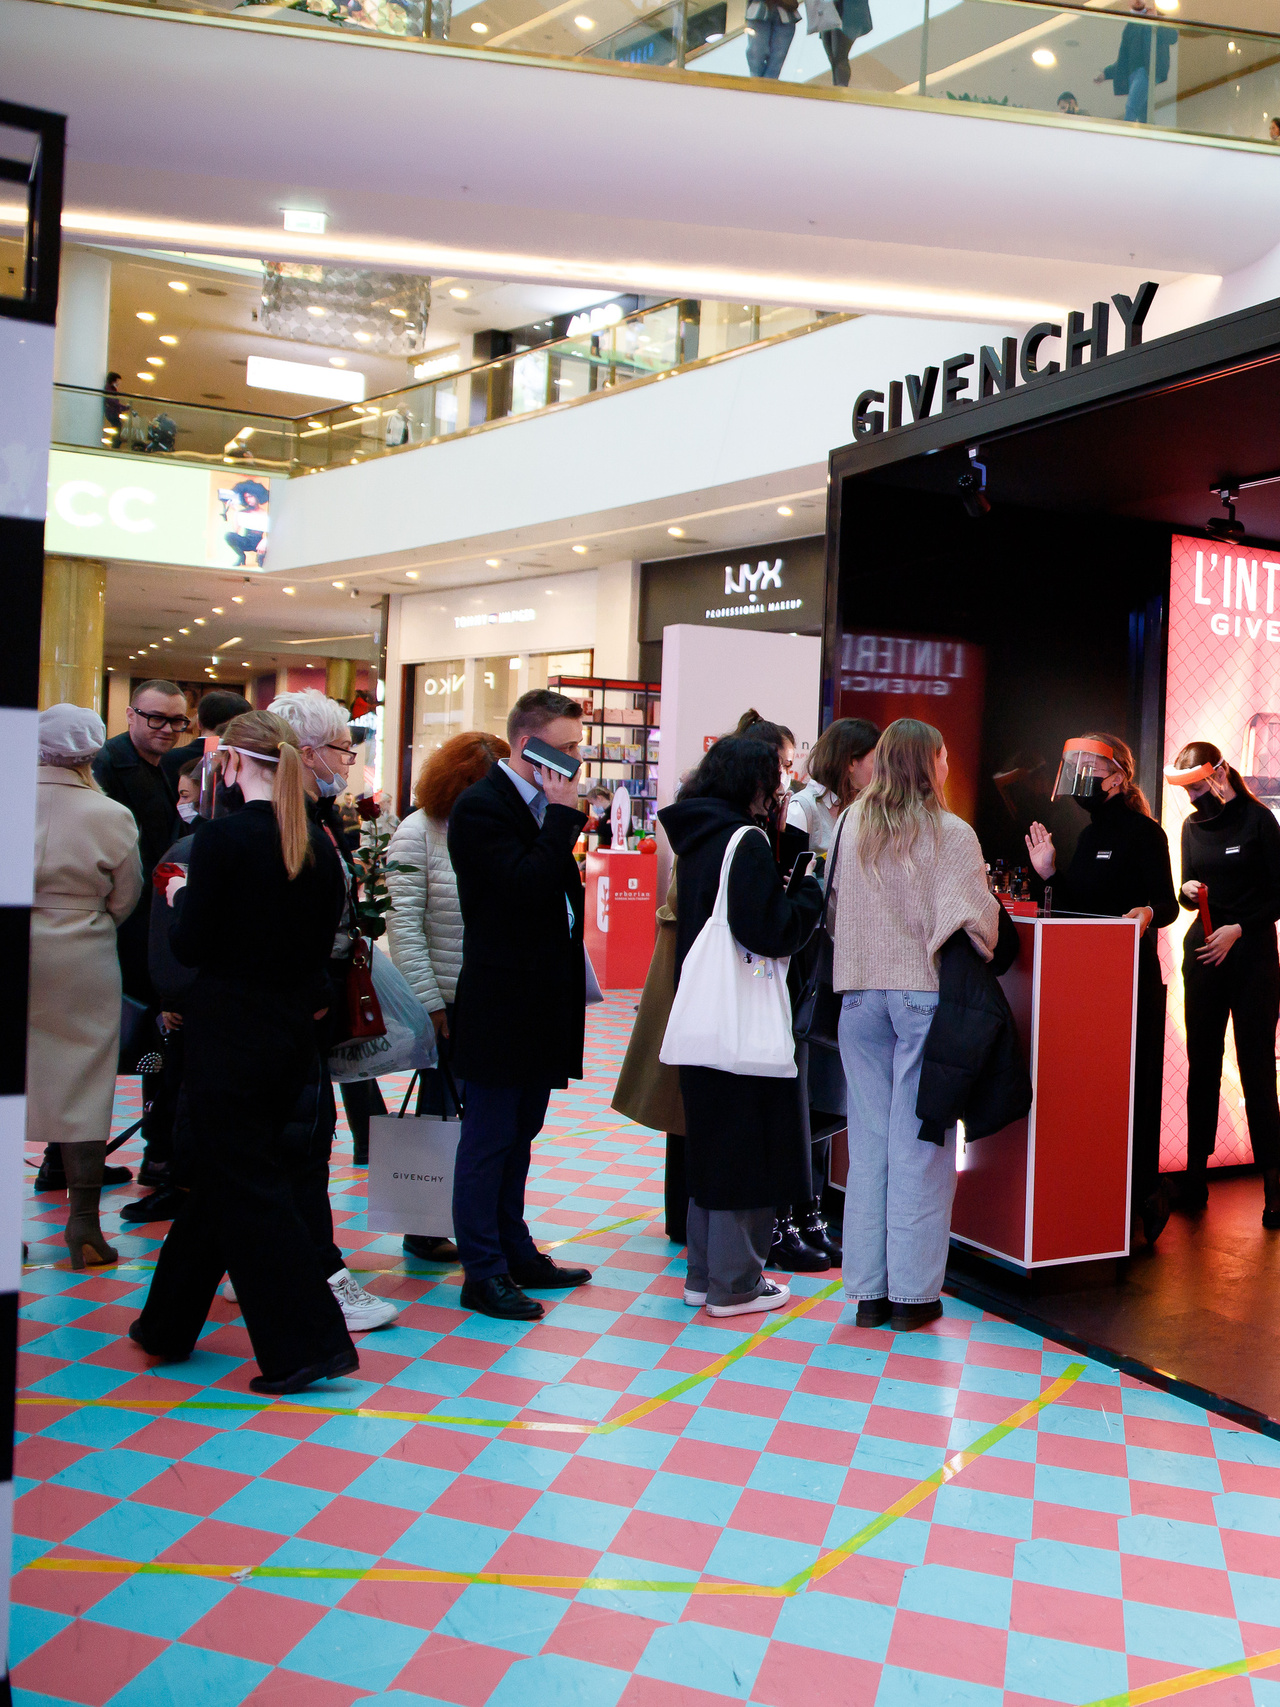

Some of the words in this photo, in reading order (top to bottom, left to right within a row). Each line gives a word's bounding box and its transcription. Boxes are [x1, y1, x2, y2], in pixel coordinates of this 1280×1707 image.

[852, 281, 1159, 441] GIVENCHY
[46, 480, 157, 533] CC
[724, 558, 783, 595] NYX
[705, 604, 765, 619] PROFESSIONAL
[767, 599, 802, 612] MAKEUP
[392, 1172, 444, 1182] GIVENCHY
